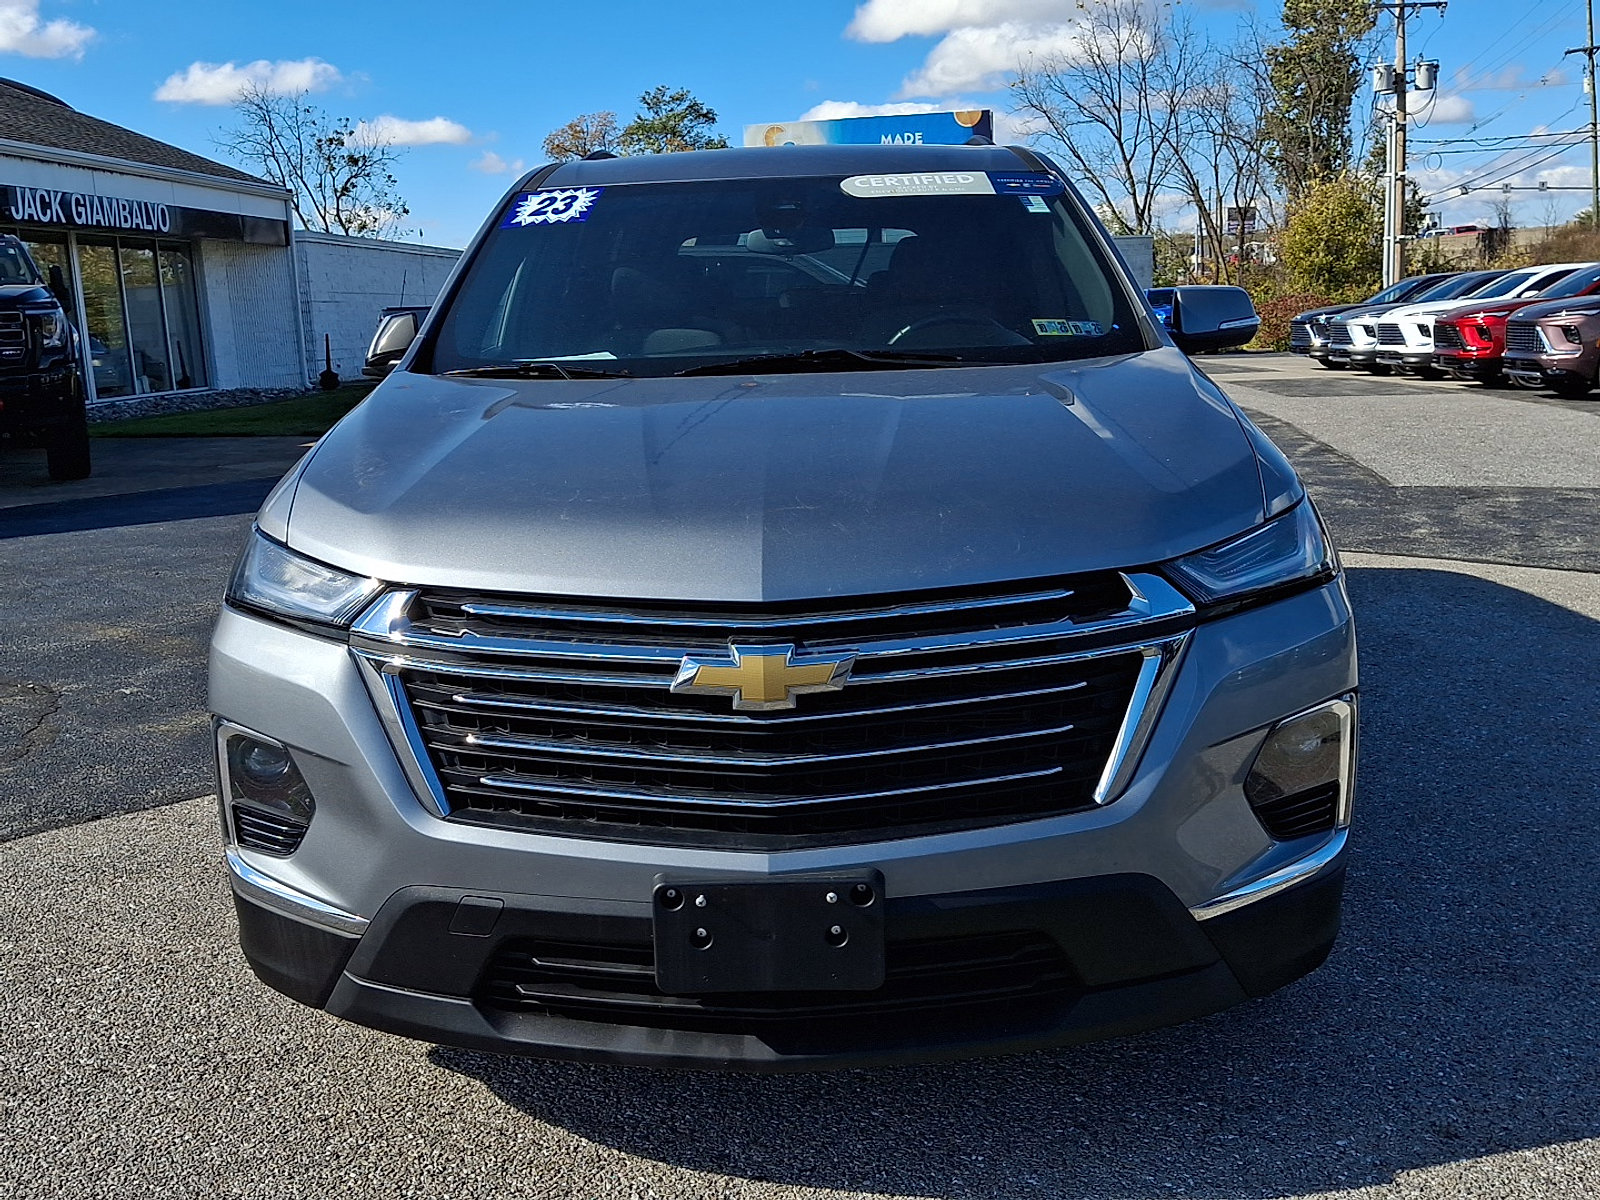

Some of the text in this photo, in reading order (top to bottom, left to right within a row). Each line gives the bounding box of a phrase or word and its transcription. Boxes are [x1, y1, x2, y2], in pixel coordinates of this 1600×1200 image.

[880, 132, 924, 145] MADE
[854, 174, 974, 187] CERTIFIED
[11, 186, 170, 233] JACK GIAMBALVO
[527, 194, 579, 216] 23
